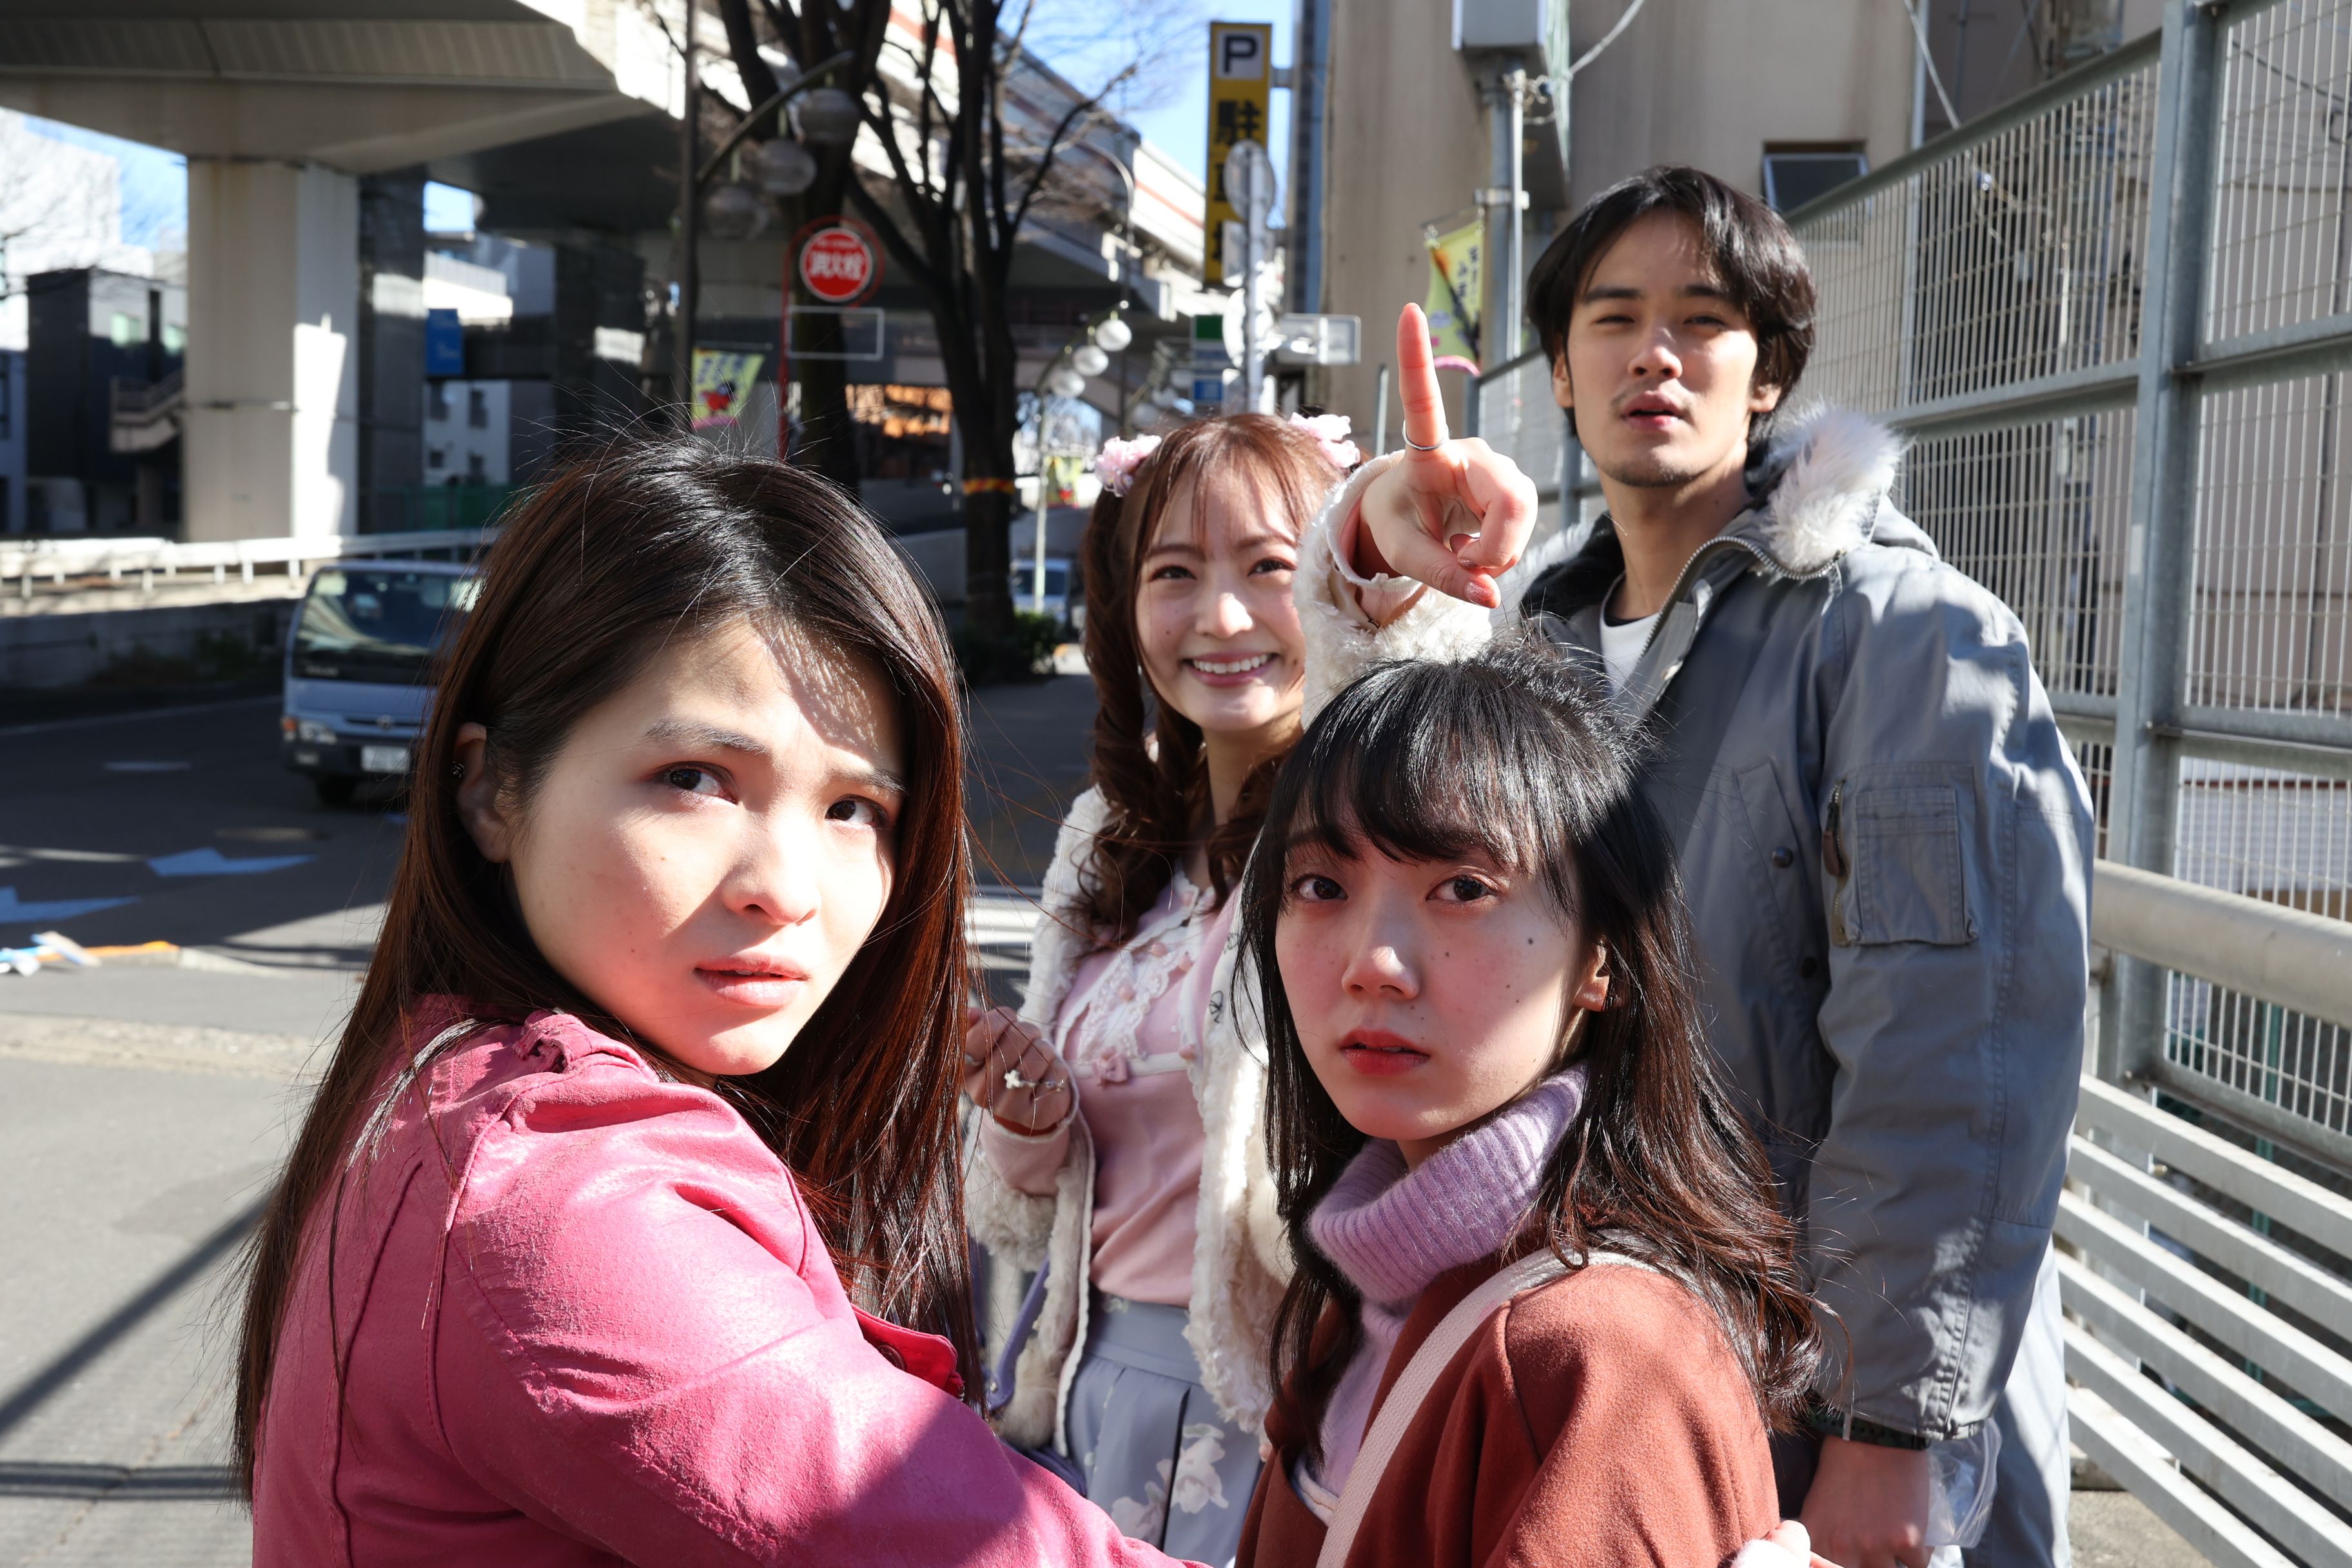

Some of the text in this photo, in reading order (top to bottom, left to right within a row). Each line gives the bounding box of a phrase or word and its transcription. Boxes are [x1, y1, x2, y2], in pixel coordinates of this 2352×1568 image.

[1224, 35, 1257, 74] P
[812, 251, 861, 280] 消火栓
